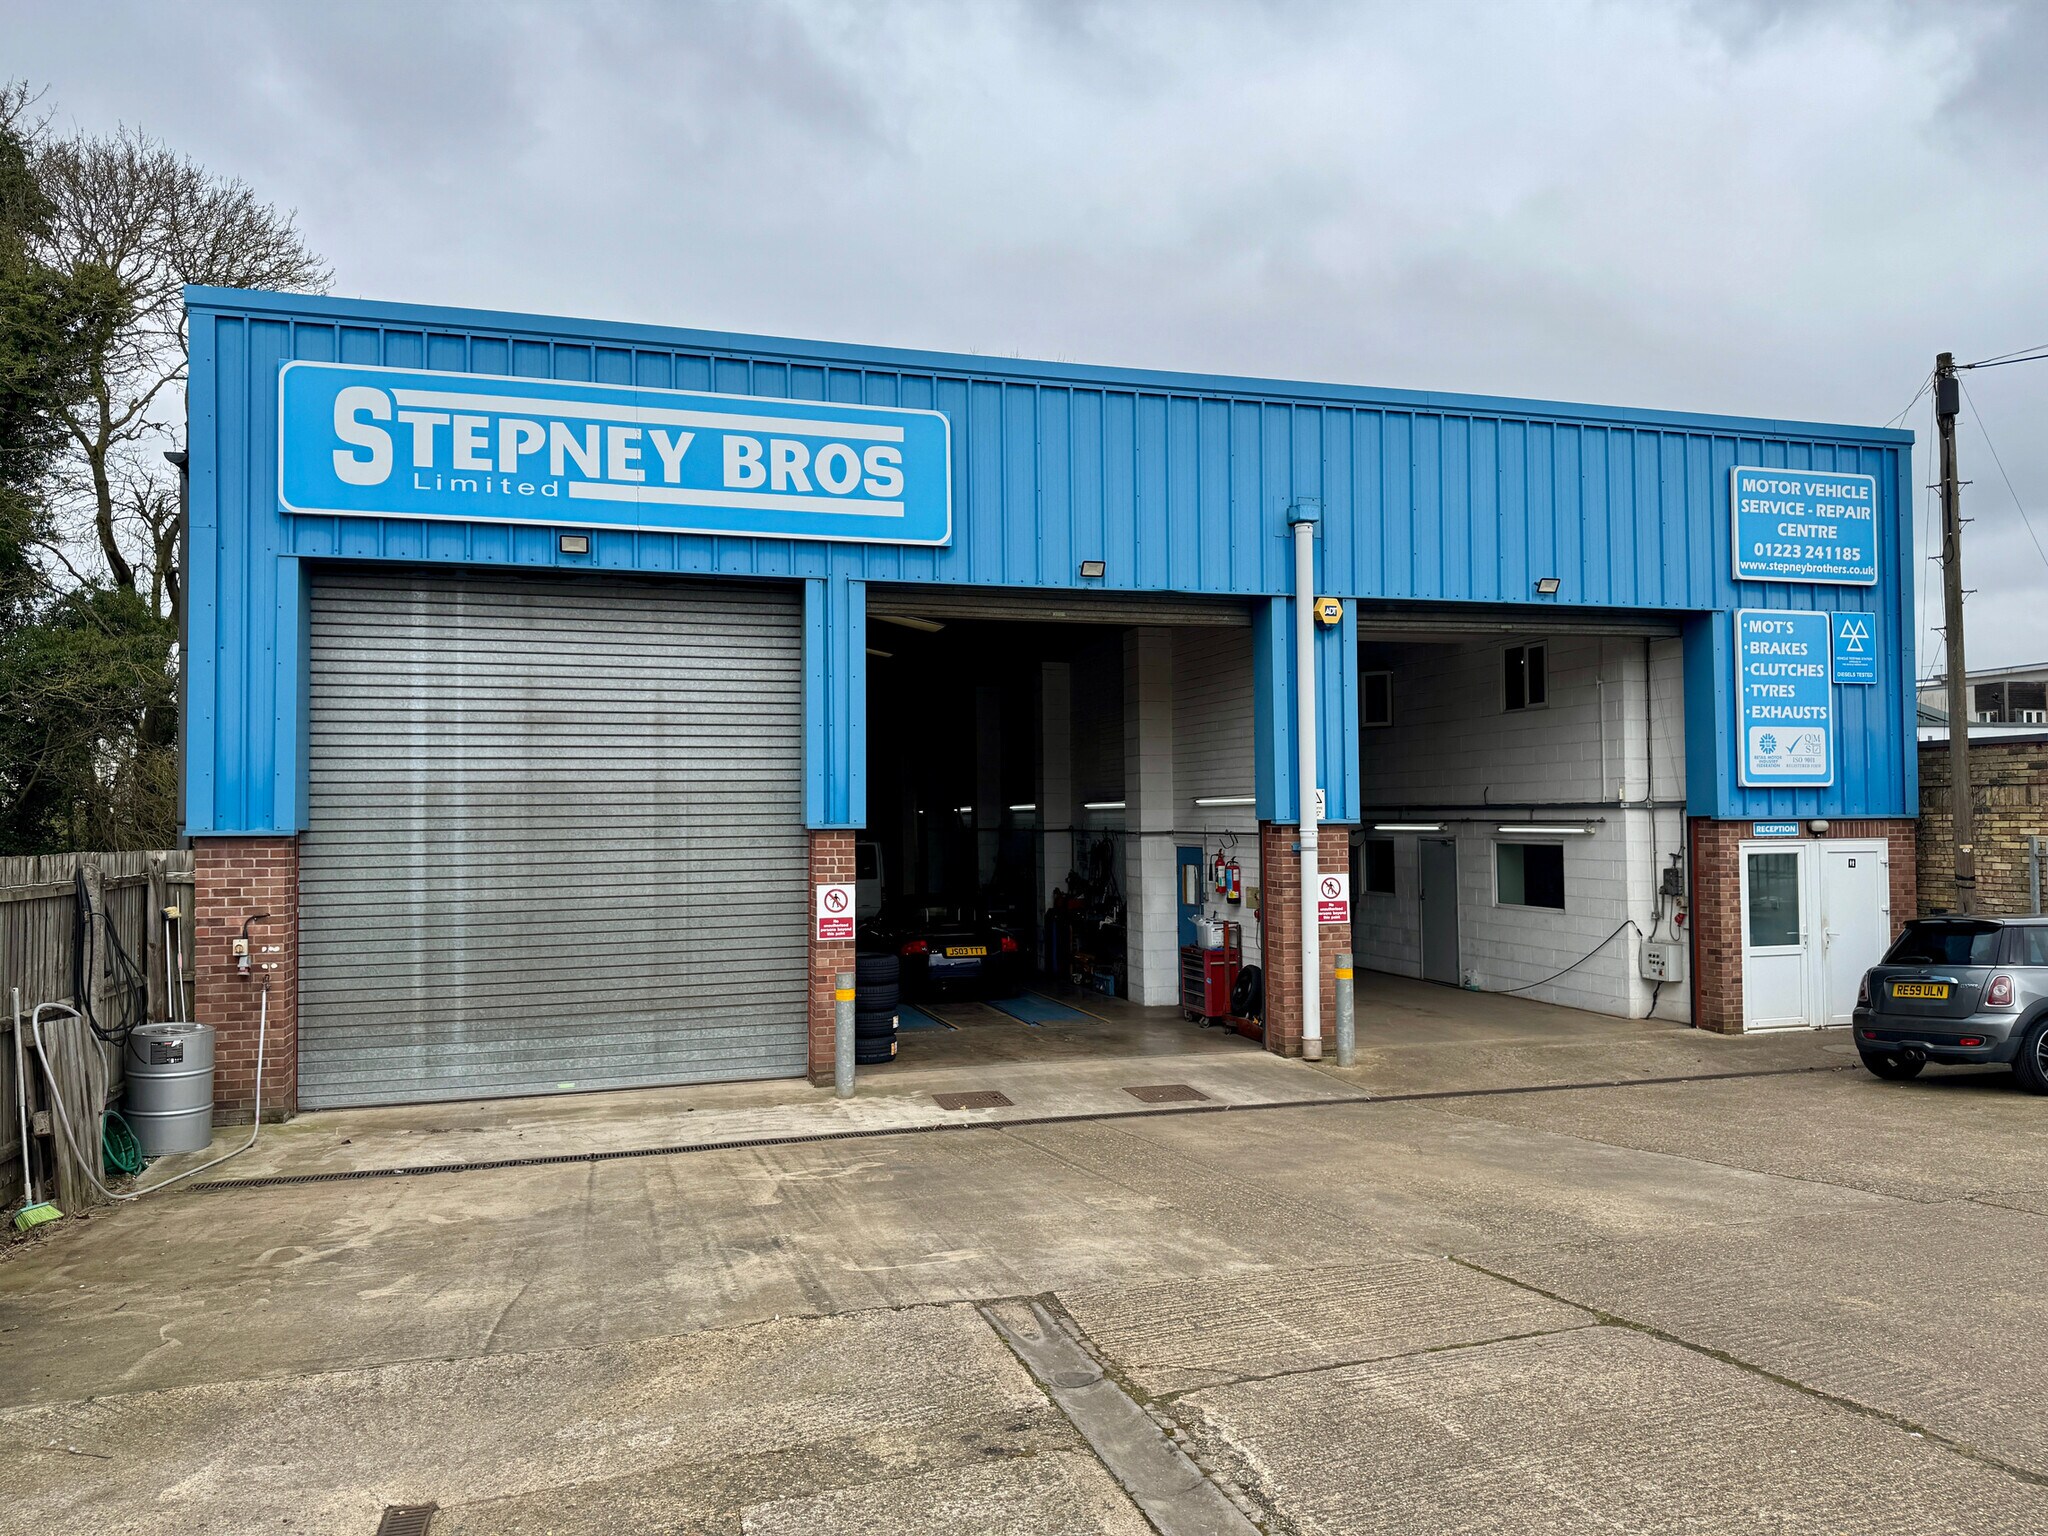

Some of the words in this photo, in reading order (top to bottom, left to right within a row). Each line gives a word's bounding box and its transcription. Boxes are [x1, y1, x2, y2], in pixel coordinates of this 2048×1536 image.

[333, 386, 696, 486] STEPNEY
[723, 434, 904, 498] BROS
[414, 472, 558, 497] Limited
[1742, 478, 1800, 496] MOTOR
[1804, 483, 1868, 500] VEHICLE
[1741, 499, 1804, 516] SERVICE
[1816, 504, 1870, 520] REPAIR
[1777, 522, 1838, 539] CENTRE
[1754, 542, 1801, 558] 01223
[1805, 546, 1861, 561] 241185
[1740, 560, 1874, 576] www.stepneybrothers.co.uk
[1325, 606, 1337, 616] ADT
[1749, 620, 1794, 634] MOT'S
[1750, 642, 1808, 656] BRAKES
[1750, 662, 1824, 678] CLUTCHES
[1750, 684, 1796, 698] TYRES
[1752, 706, 1827, 719] EXHAUSTS
[1897, 985, 1921, 995] RE59
[1924, 986, 1943, 996] ULN
